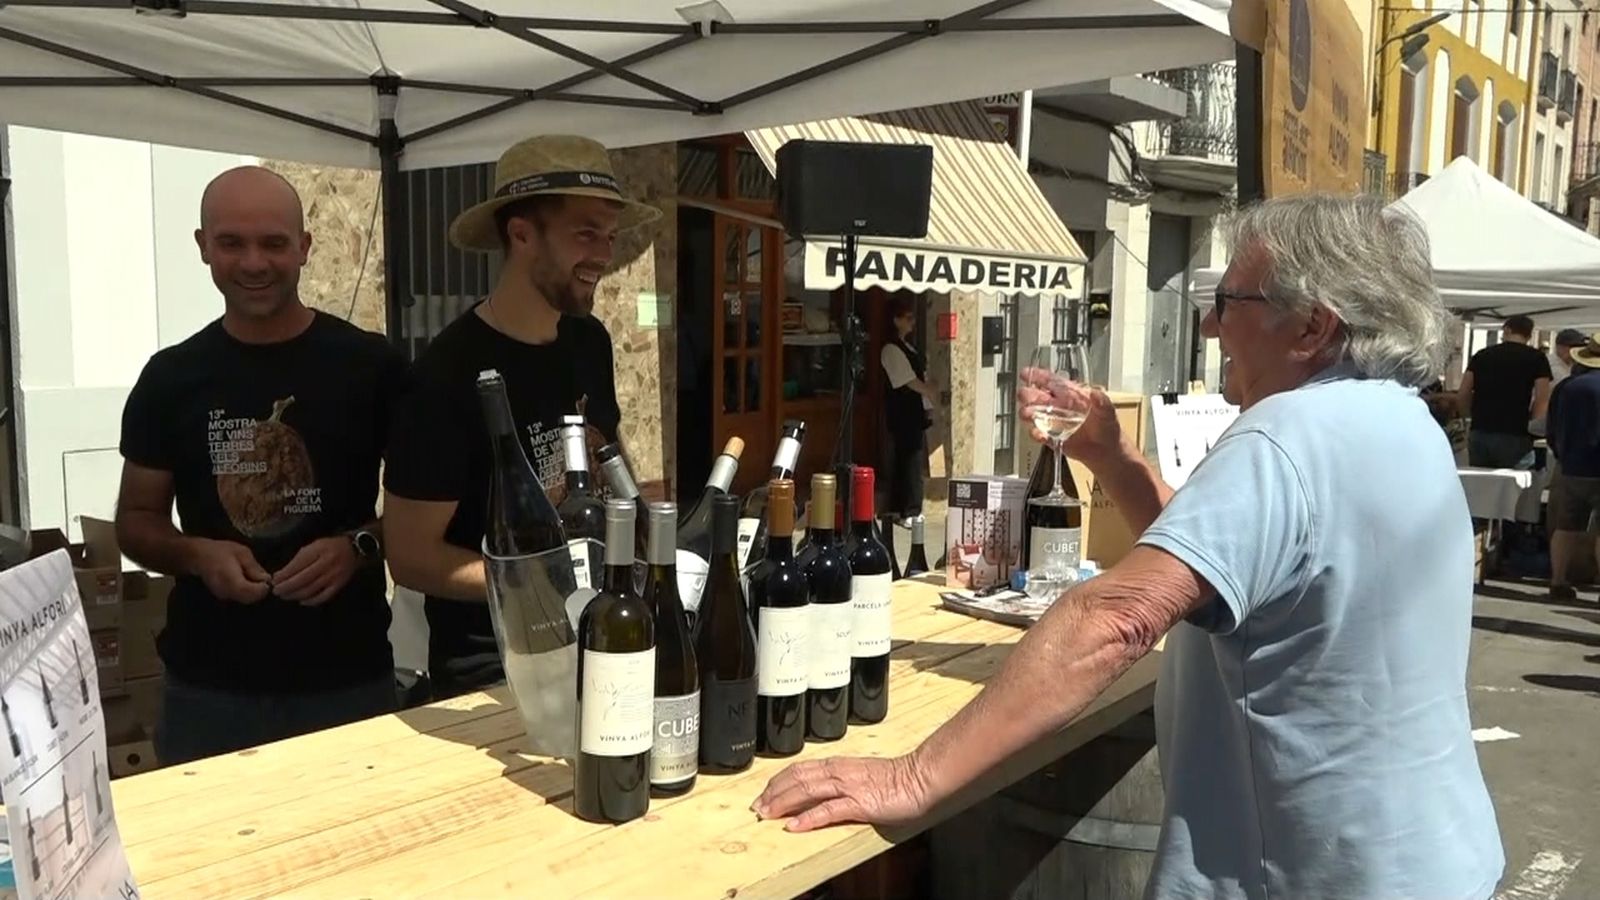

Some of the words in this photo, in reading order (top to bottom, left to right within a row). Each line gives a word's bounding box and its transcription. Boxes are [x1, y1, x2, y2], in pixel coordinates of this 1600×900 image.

[825, 246, 1073, 291] PANADERIA
[208, 418, 257, 430] MOSTRA
[208, 431, 223, 441] DE
[226, 429, 254, 440] VINS
[208, 440, 255, 453] TERRES
[533, 445, 549, 458] DE
[210, 452, 240, 463] DELS
[212, 461, 267, 475] ALFORINS
[284, 488, 296, 497] LA
[298, 488, 321, 497] FONT
[296, 497, 308, 505] DE
[310, 497, 322, 505] LA
[283, 505, 322, 513] FIGUERA
